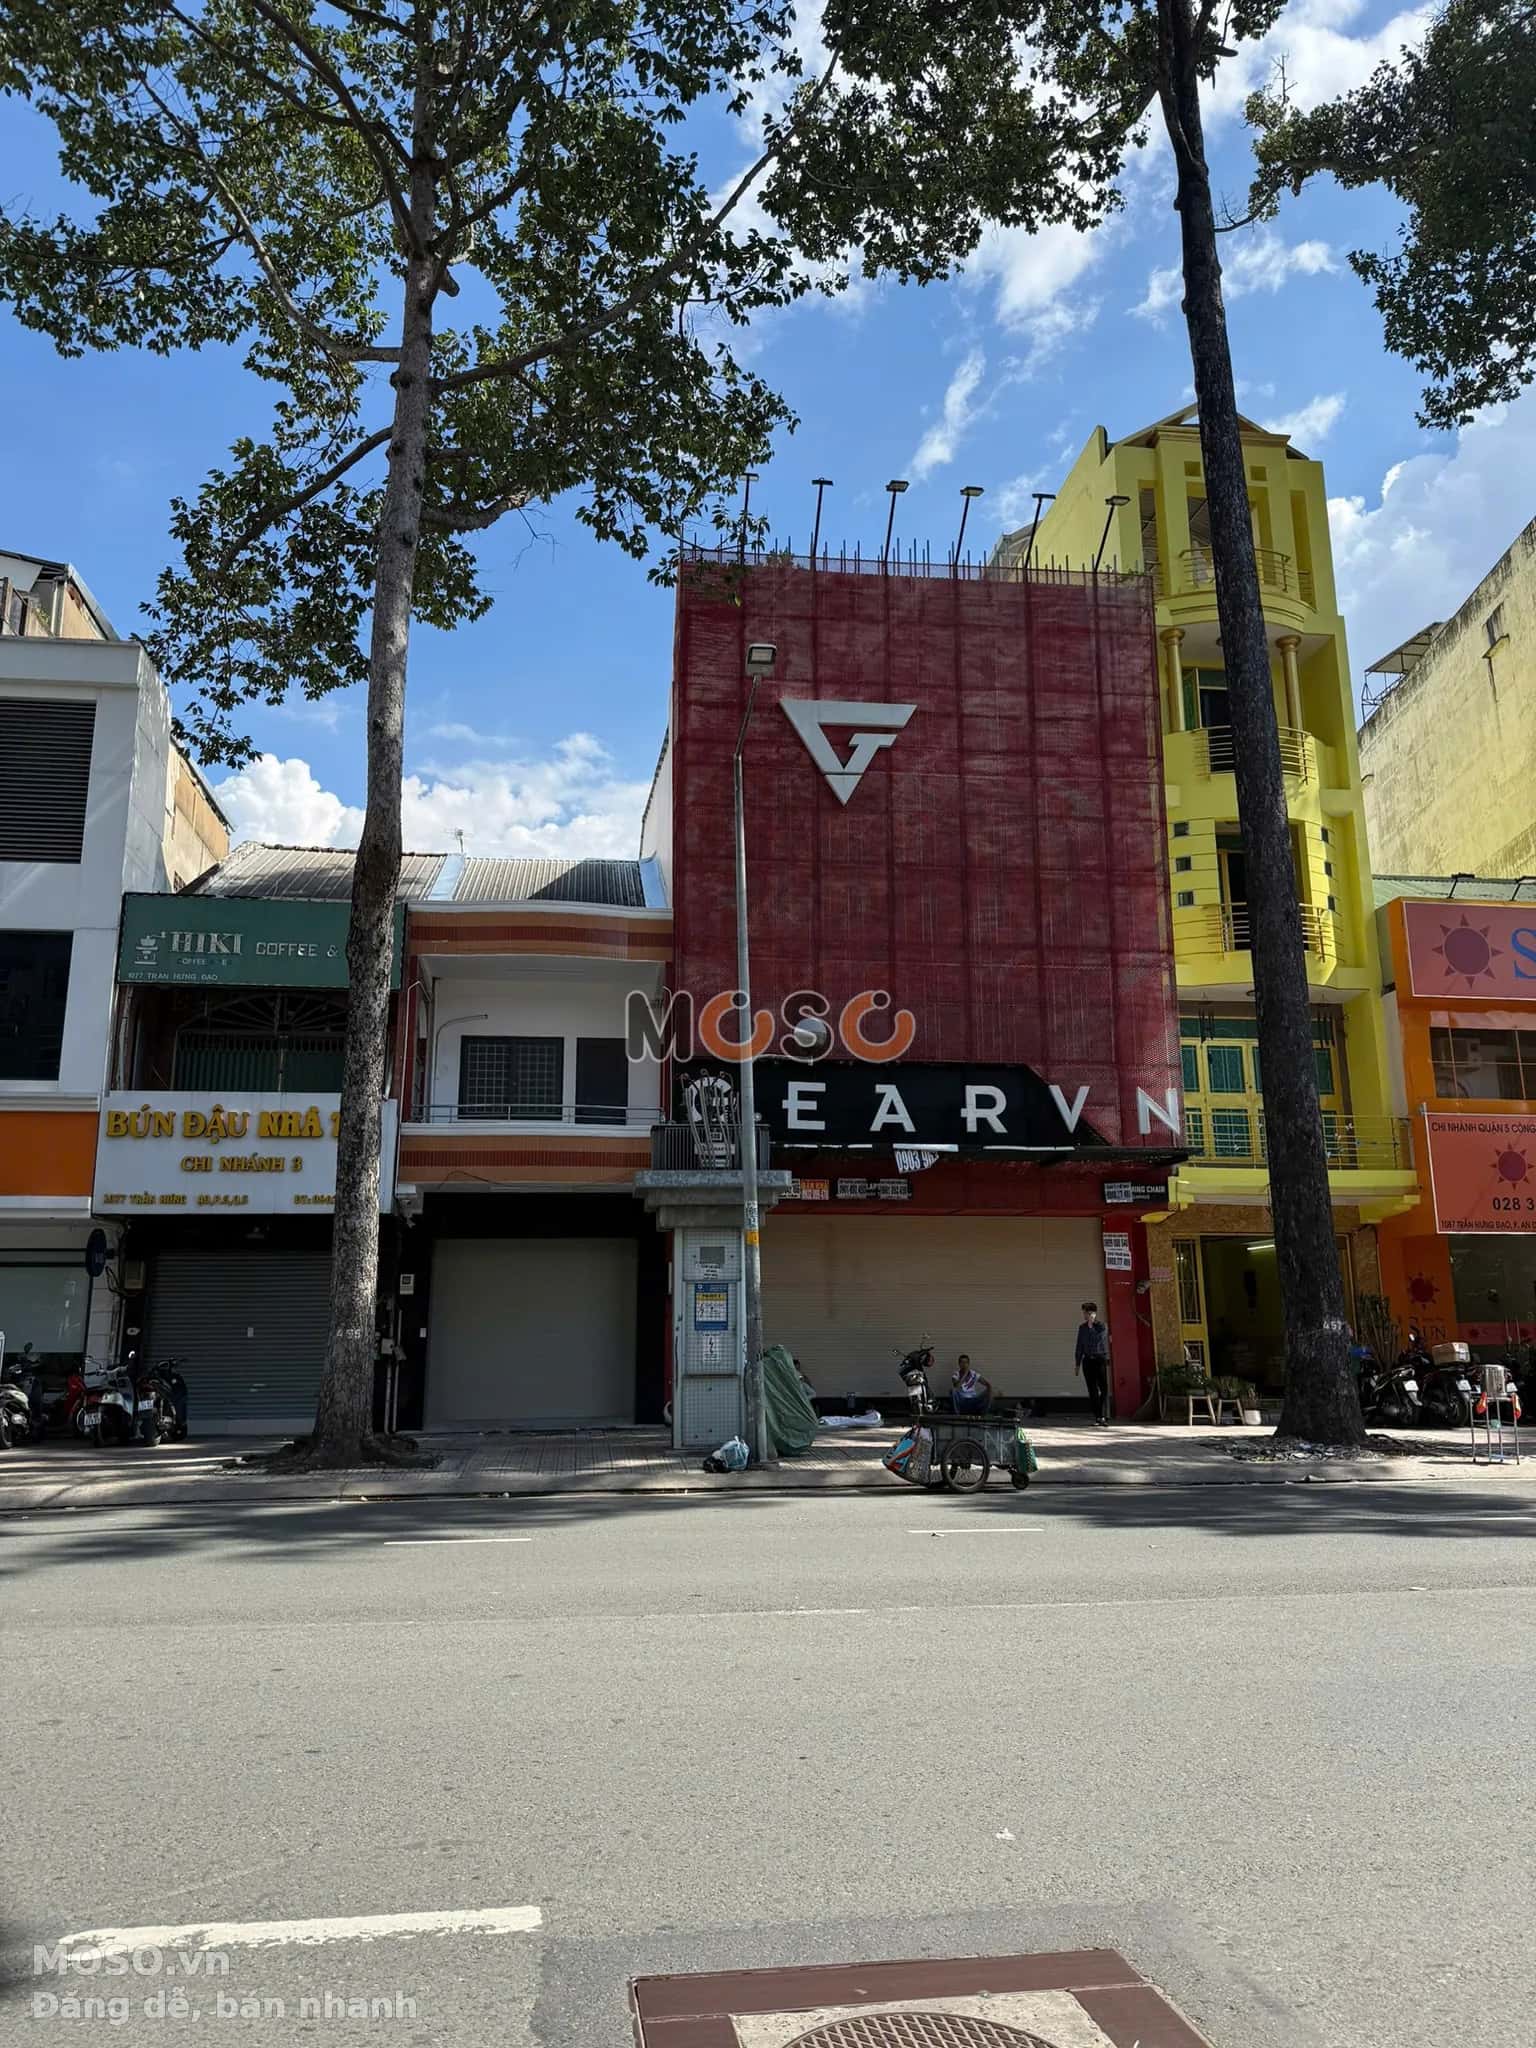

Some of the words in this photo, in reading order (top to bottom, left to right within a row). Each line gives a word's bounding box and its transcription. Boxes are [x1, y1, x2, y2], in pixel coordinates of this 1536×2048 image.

[255, 942, 319, 957] COFFEE
[327, 944, 338, 957] &
[106, 1104, 176, 1138] BÚN
[182, 1103, 250, 1145] ĐẬU
[1432, 1121, 1446, 1132] CHI
[181, 1157, 213, 1172] CHI
[219, 1153, 285, 1172] NHÁNH
[290, 1157, 303, 1171] 3
[895, 1150, 921, 1170] 0903
[1493, 1197, 1521, 1211] 028
[1526, 1197, 1536, 1211] 3
